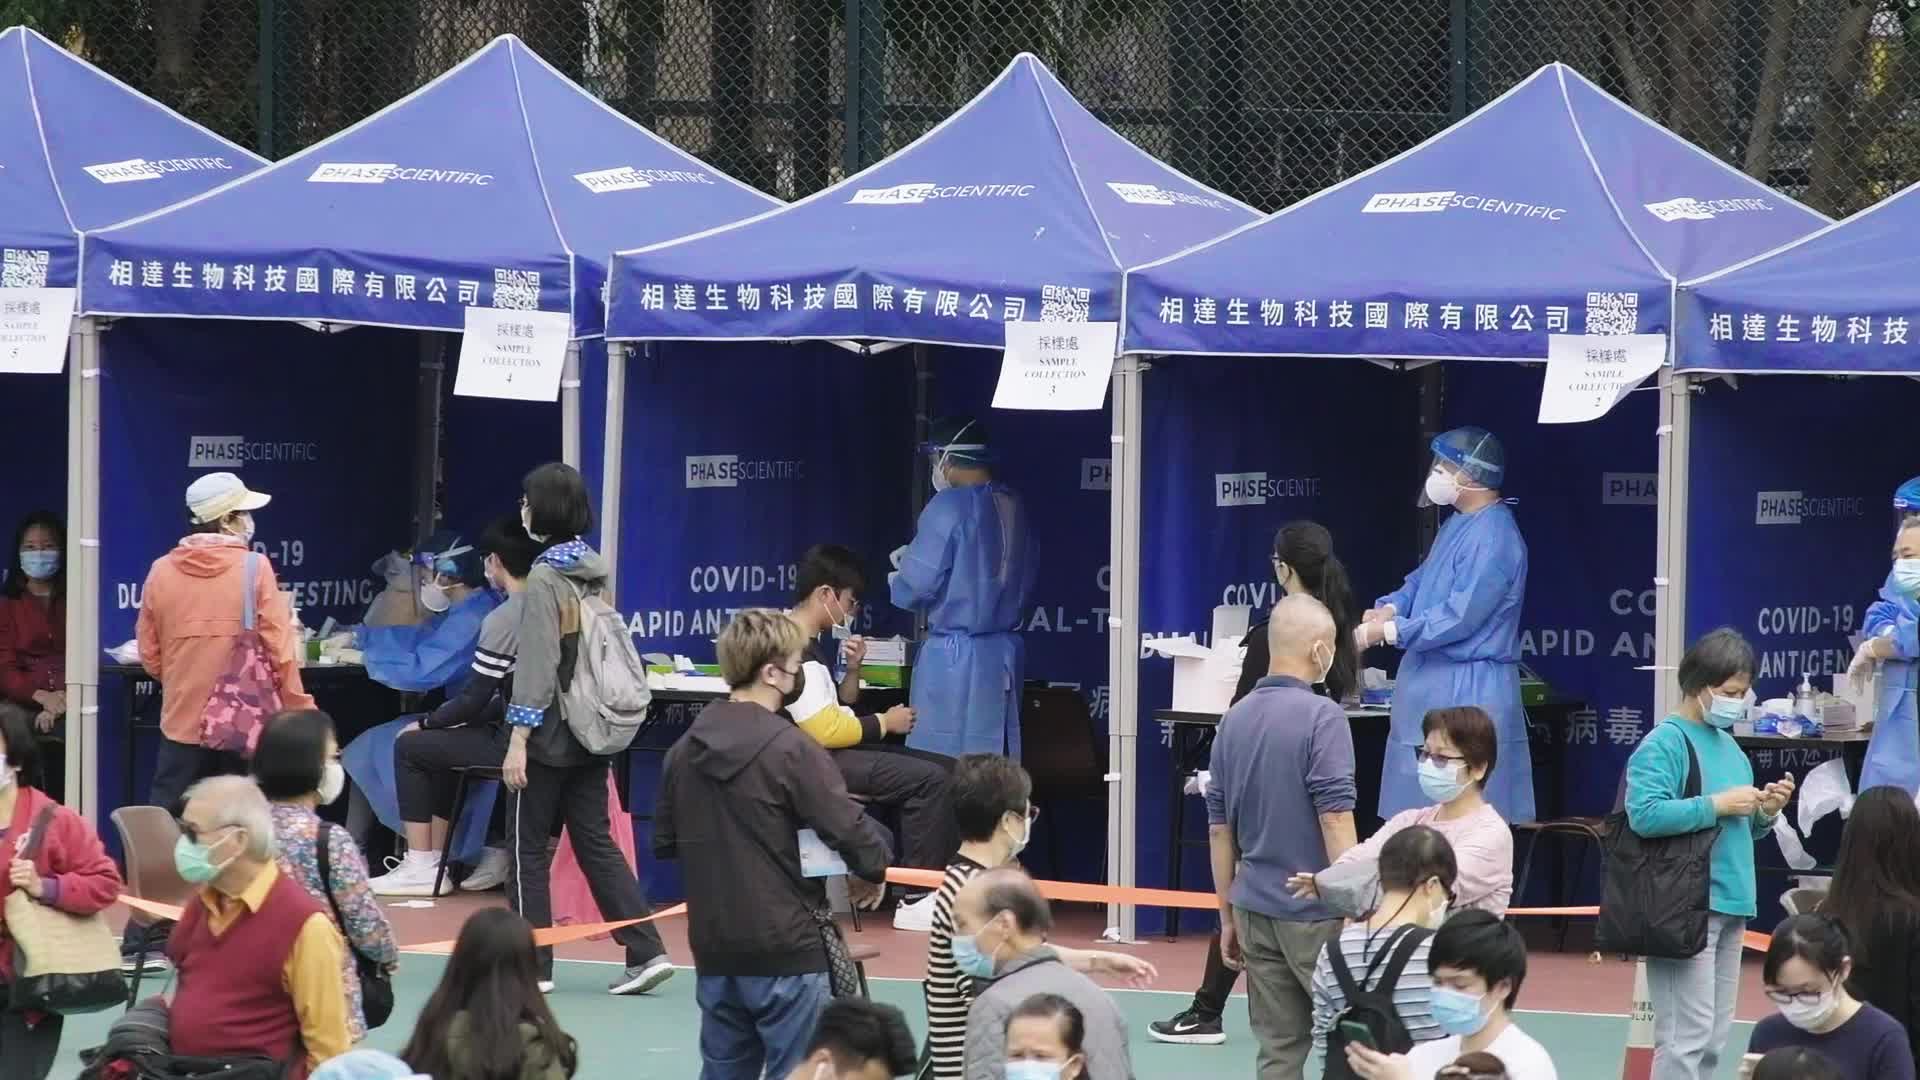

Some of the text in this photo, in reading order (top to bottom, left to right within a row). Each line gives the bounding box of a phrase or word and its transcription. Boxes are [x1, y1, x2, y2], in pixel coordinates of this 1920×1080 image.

[1374, 194, 1567, 220] PHASESCIENTIFIC
[108, 258, 480, 306] 相達生物科技國際有限公司
[640, 282, 1026, 321] 相達生物科技國際有限公司
[1159, 295, 1569, 332] 相達生物科技國際有限公司
[1709, 312, 1910, 345] 相達生物科技
[496, 344, 532, 354] SAMPLE
[1039, 357, 1077, 367] SAMPLE
[1584, 369, 1625, 379] SAMPLE
[690, 564, 798, 593] COVID-19
[1758, 604, 1854, 635] COVID-19
[1519, 629, 1595, 656] APID
[1759, 649, 1850, 679] ANTIGEN
